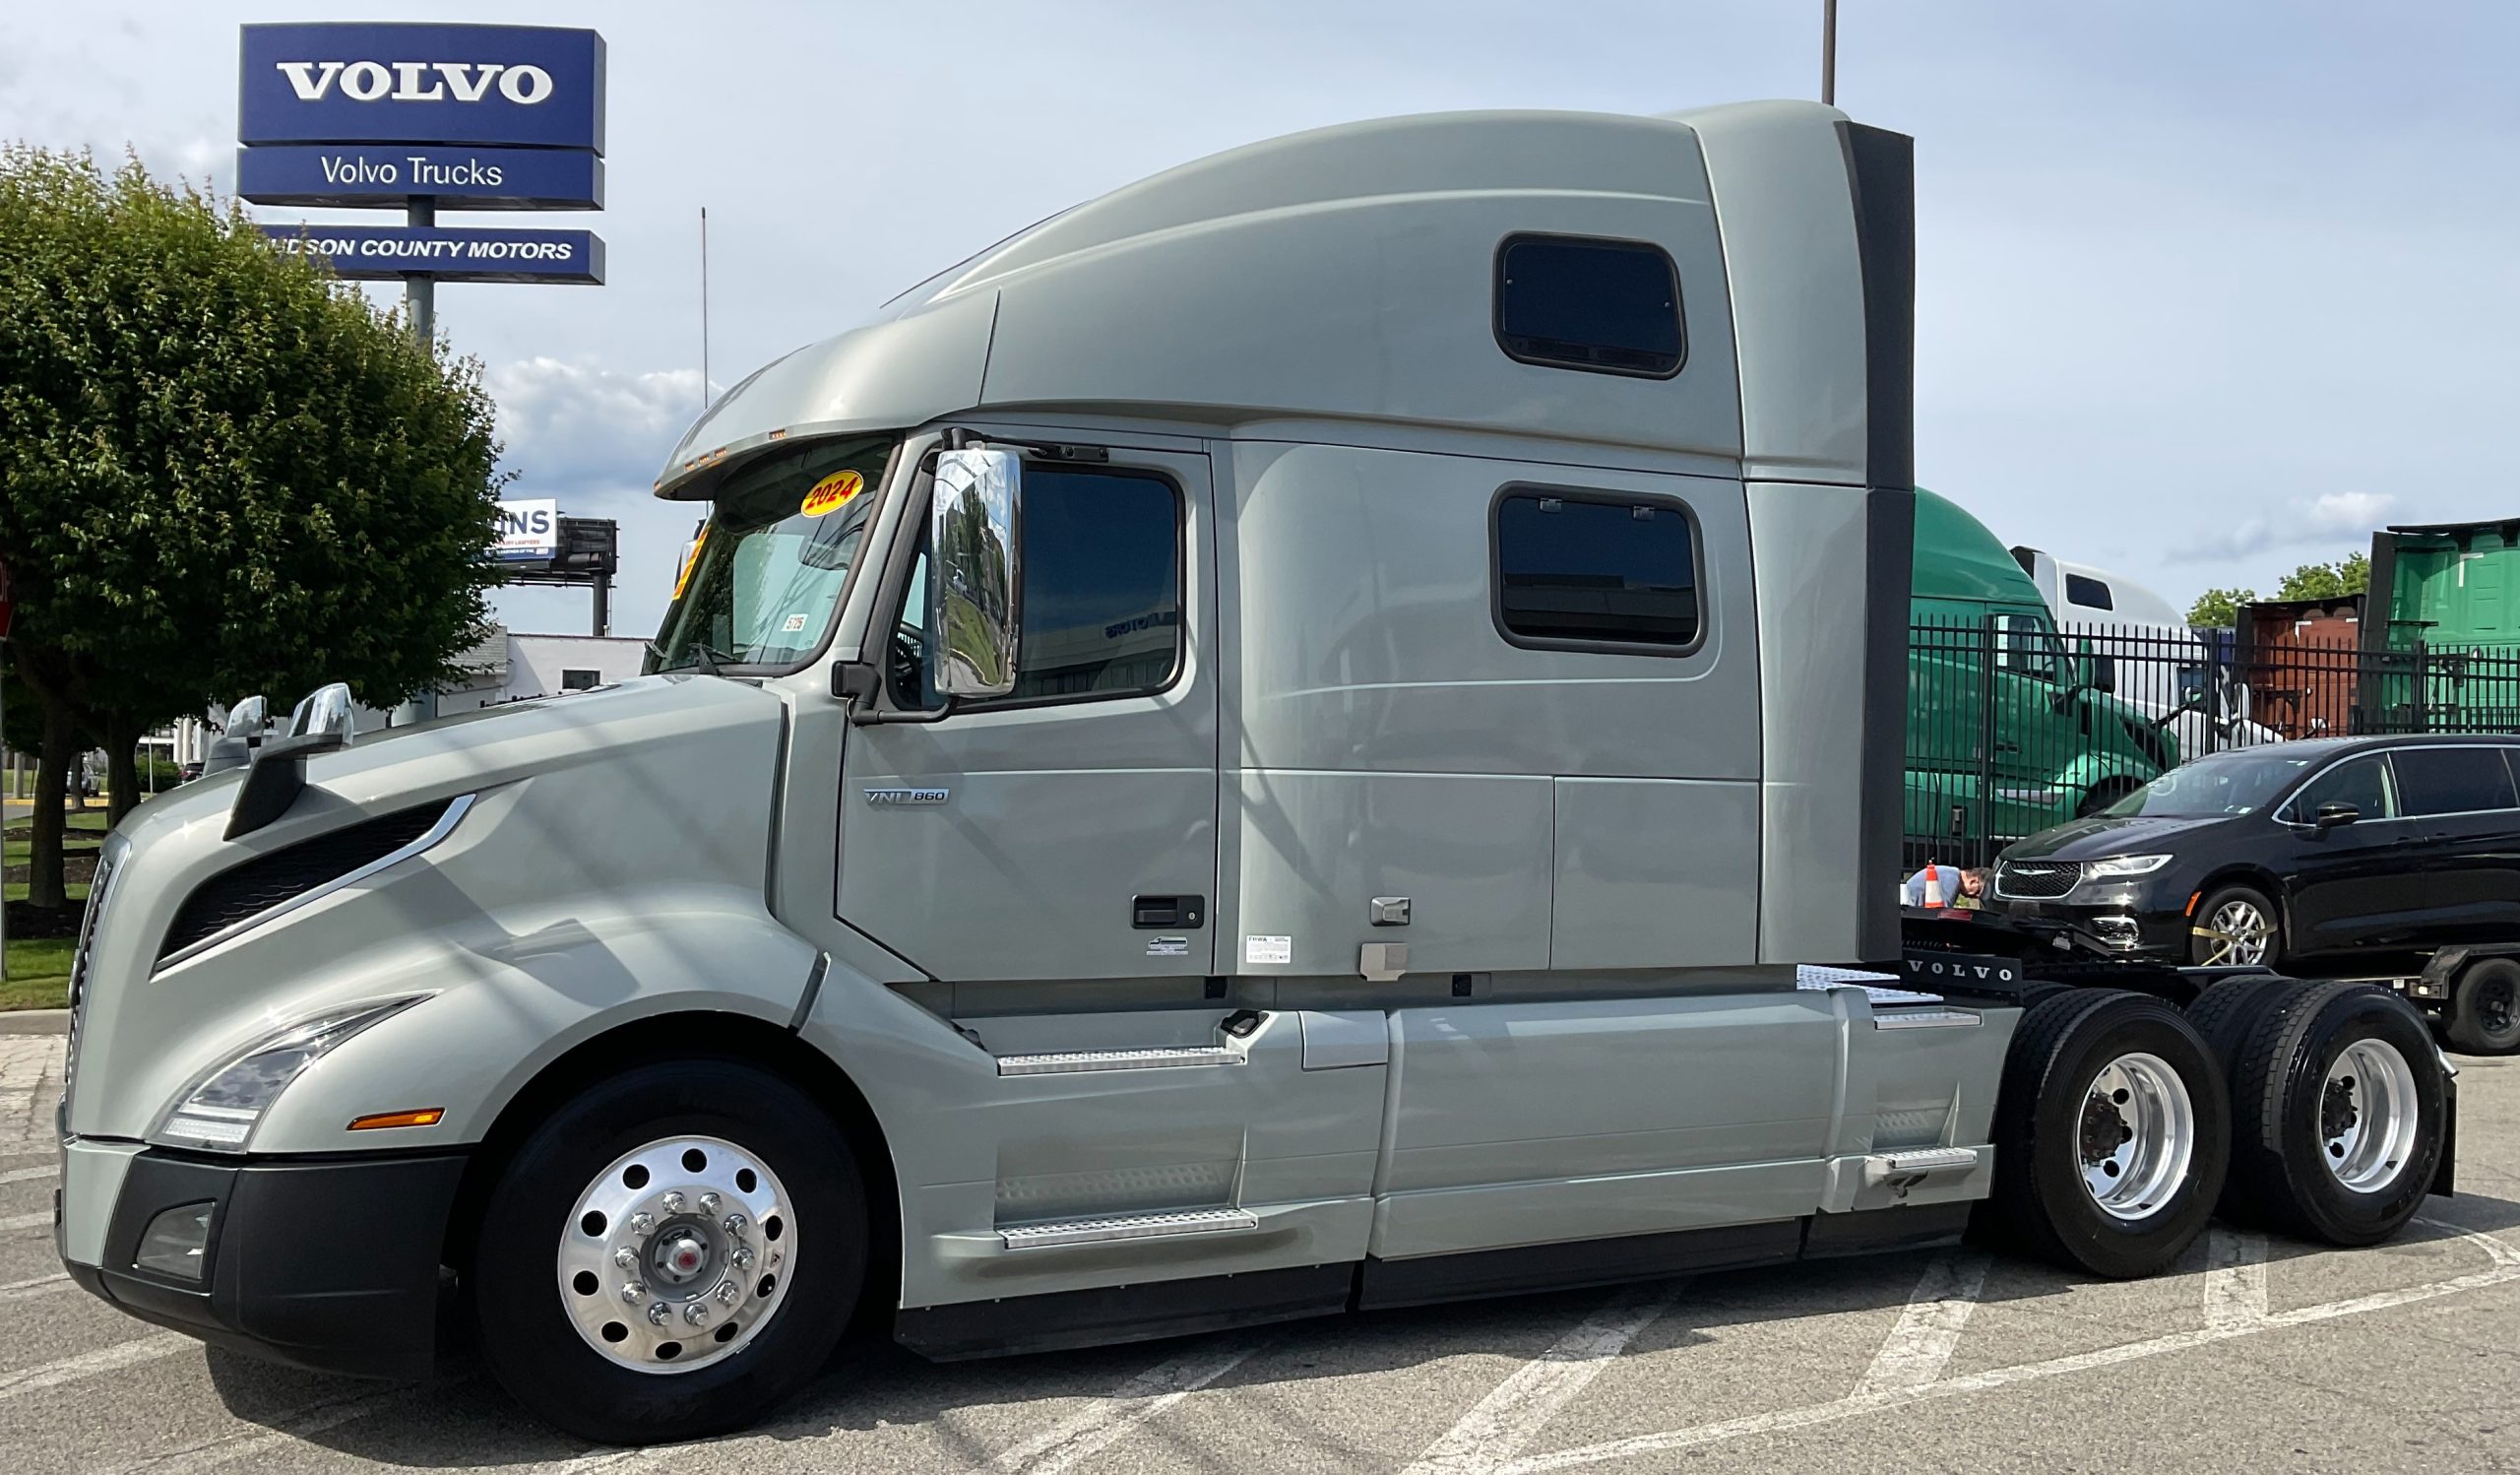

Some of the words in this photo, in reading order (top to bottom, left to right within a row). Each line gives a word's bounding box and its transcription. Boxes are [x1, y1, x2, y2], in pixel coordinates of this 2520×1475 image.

[277, 60, 553, 104] VOLVO
[320, 156, 397, 184] Volvo
[407, 157, 503, 186] Trucks
[360, 238, 465, 258] COUNTY
[468, 242, 573, 261] MOTORS
[804, 476, 859, 510] 2024
[914, 792, 945, 801] 860
[1907, 959, 2013, 982] VOLVO
